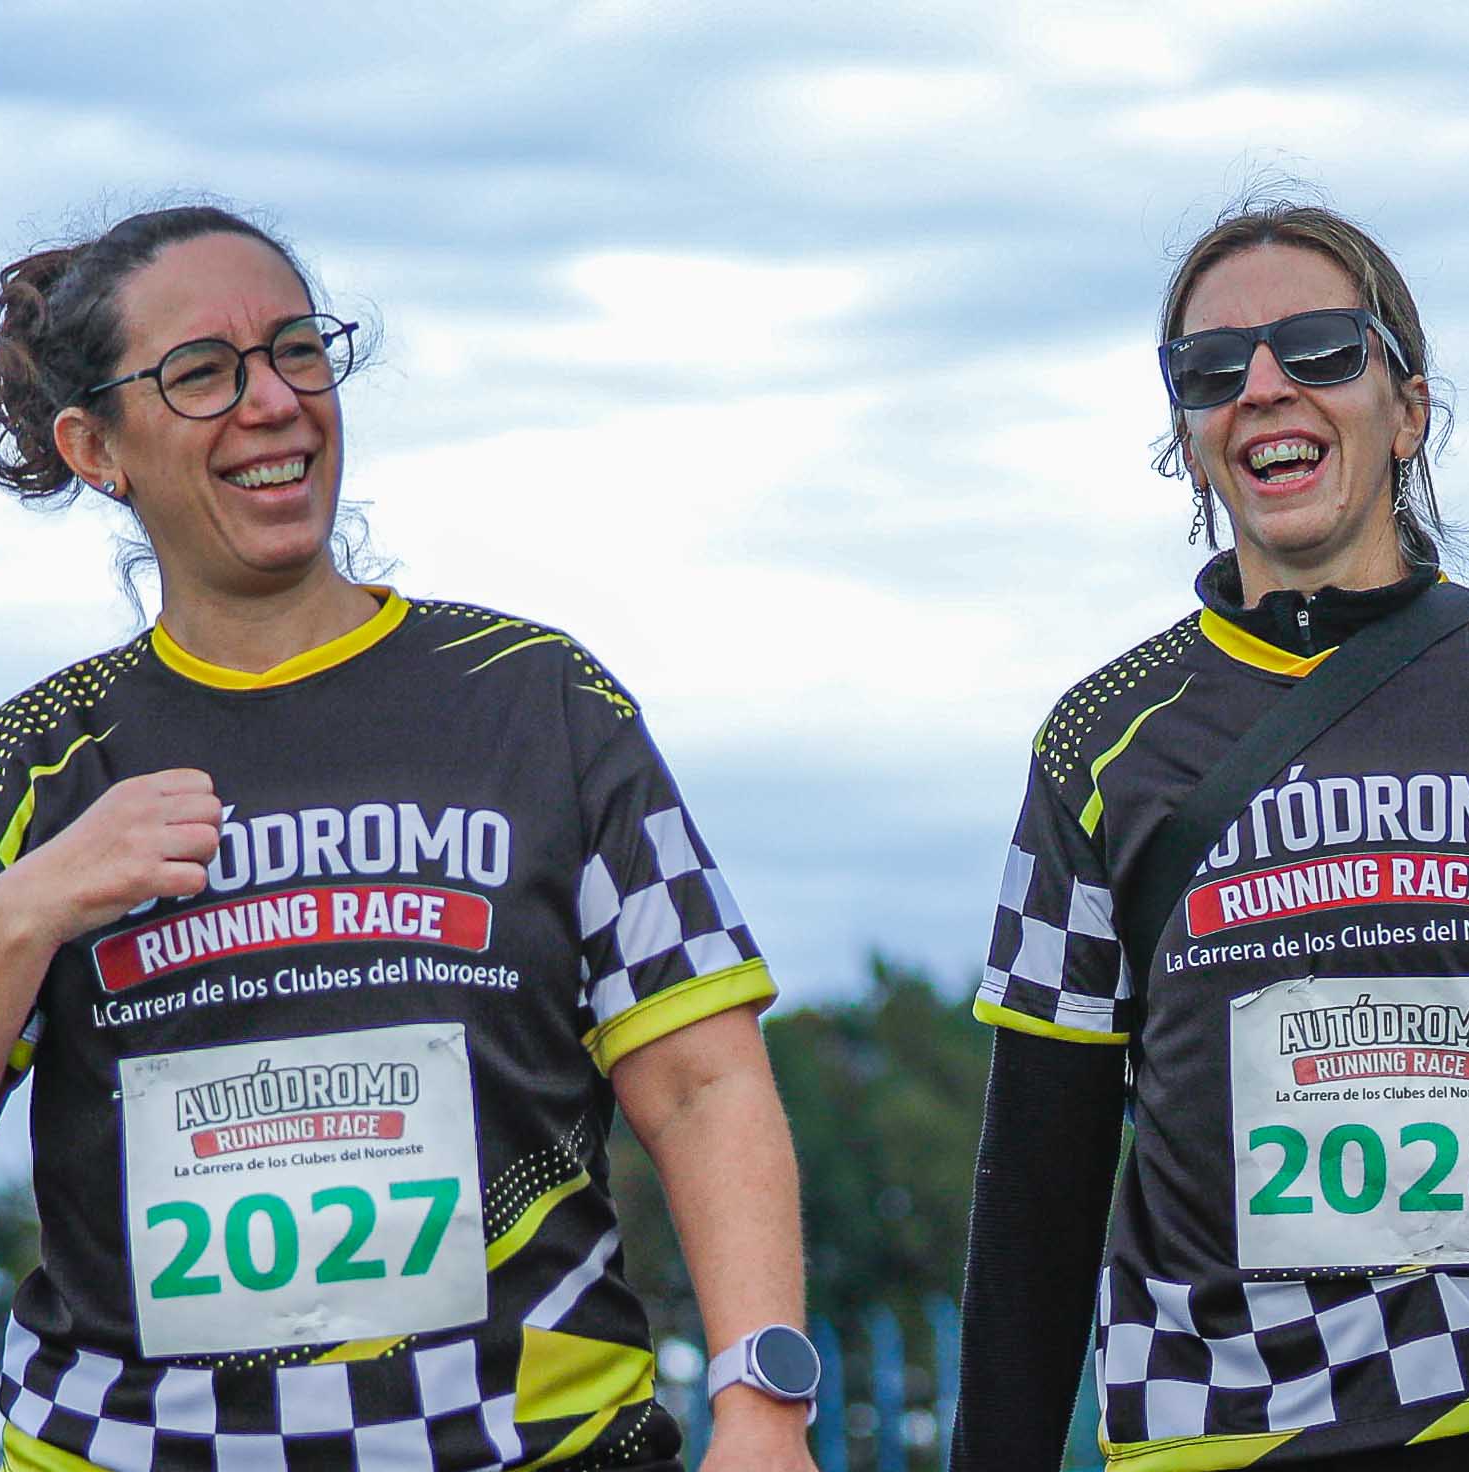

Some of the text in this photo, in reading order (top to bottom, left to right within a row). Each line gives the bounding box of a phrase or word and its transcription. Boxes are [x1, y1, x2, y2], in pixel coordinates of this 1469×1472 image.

[1218, 859, 1379, 924] RUNNING
[136, 891, 445, 976] RUNNING RACE
[1165, 952, 1184, 974] La
[1187, 941, 1266, 967] Carrera
[1272, 935, 1300, 958] de
[1305, 932, 1335, 955] los
[1341, 923, 1416, 948] Clubes
[1423, 919, 1457, 942] del
[106, 991, 186, 1025] Carrera
[192, 979, 224, 1005] de
[231, 975, 268, 1000] los
[274, 964, 362, 994] Clubes
[367, 956, 408, 985] del
[415, 956, 520, 990] Noroeste
[176, 1059, 419, 1131] AUTÓDROMO
[1275, 1090, 1291, 1102] La
[1293, 1089, 1340, 1102] Carrera
[1343, 1087, 1358, 1101] de
[1362, 1088, 1381, 1100] los
[1383, 1087, 1425, 1100] Clubes
[1428, 1085, 1448, 1098] del
[1314, 1051, 1467, 1080] RUNNING RACE
[174, 1143, 424, 1177] La Carrera de los Clubes del Noroeste
[217, 1114, 381, 1152] RUNNING RACE
[146, 1177, 460, 1299] 2027
